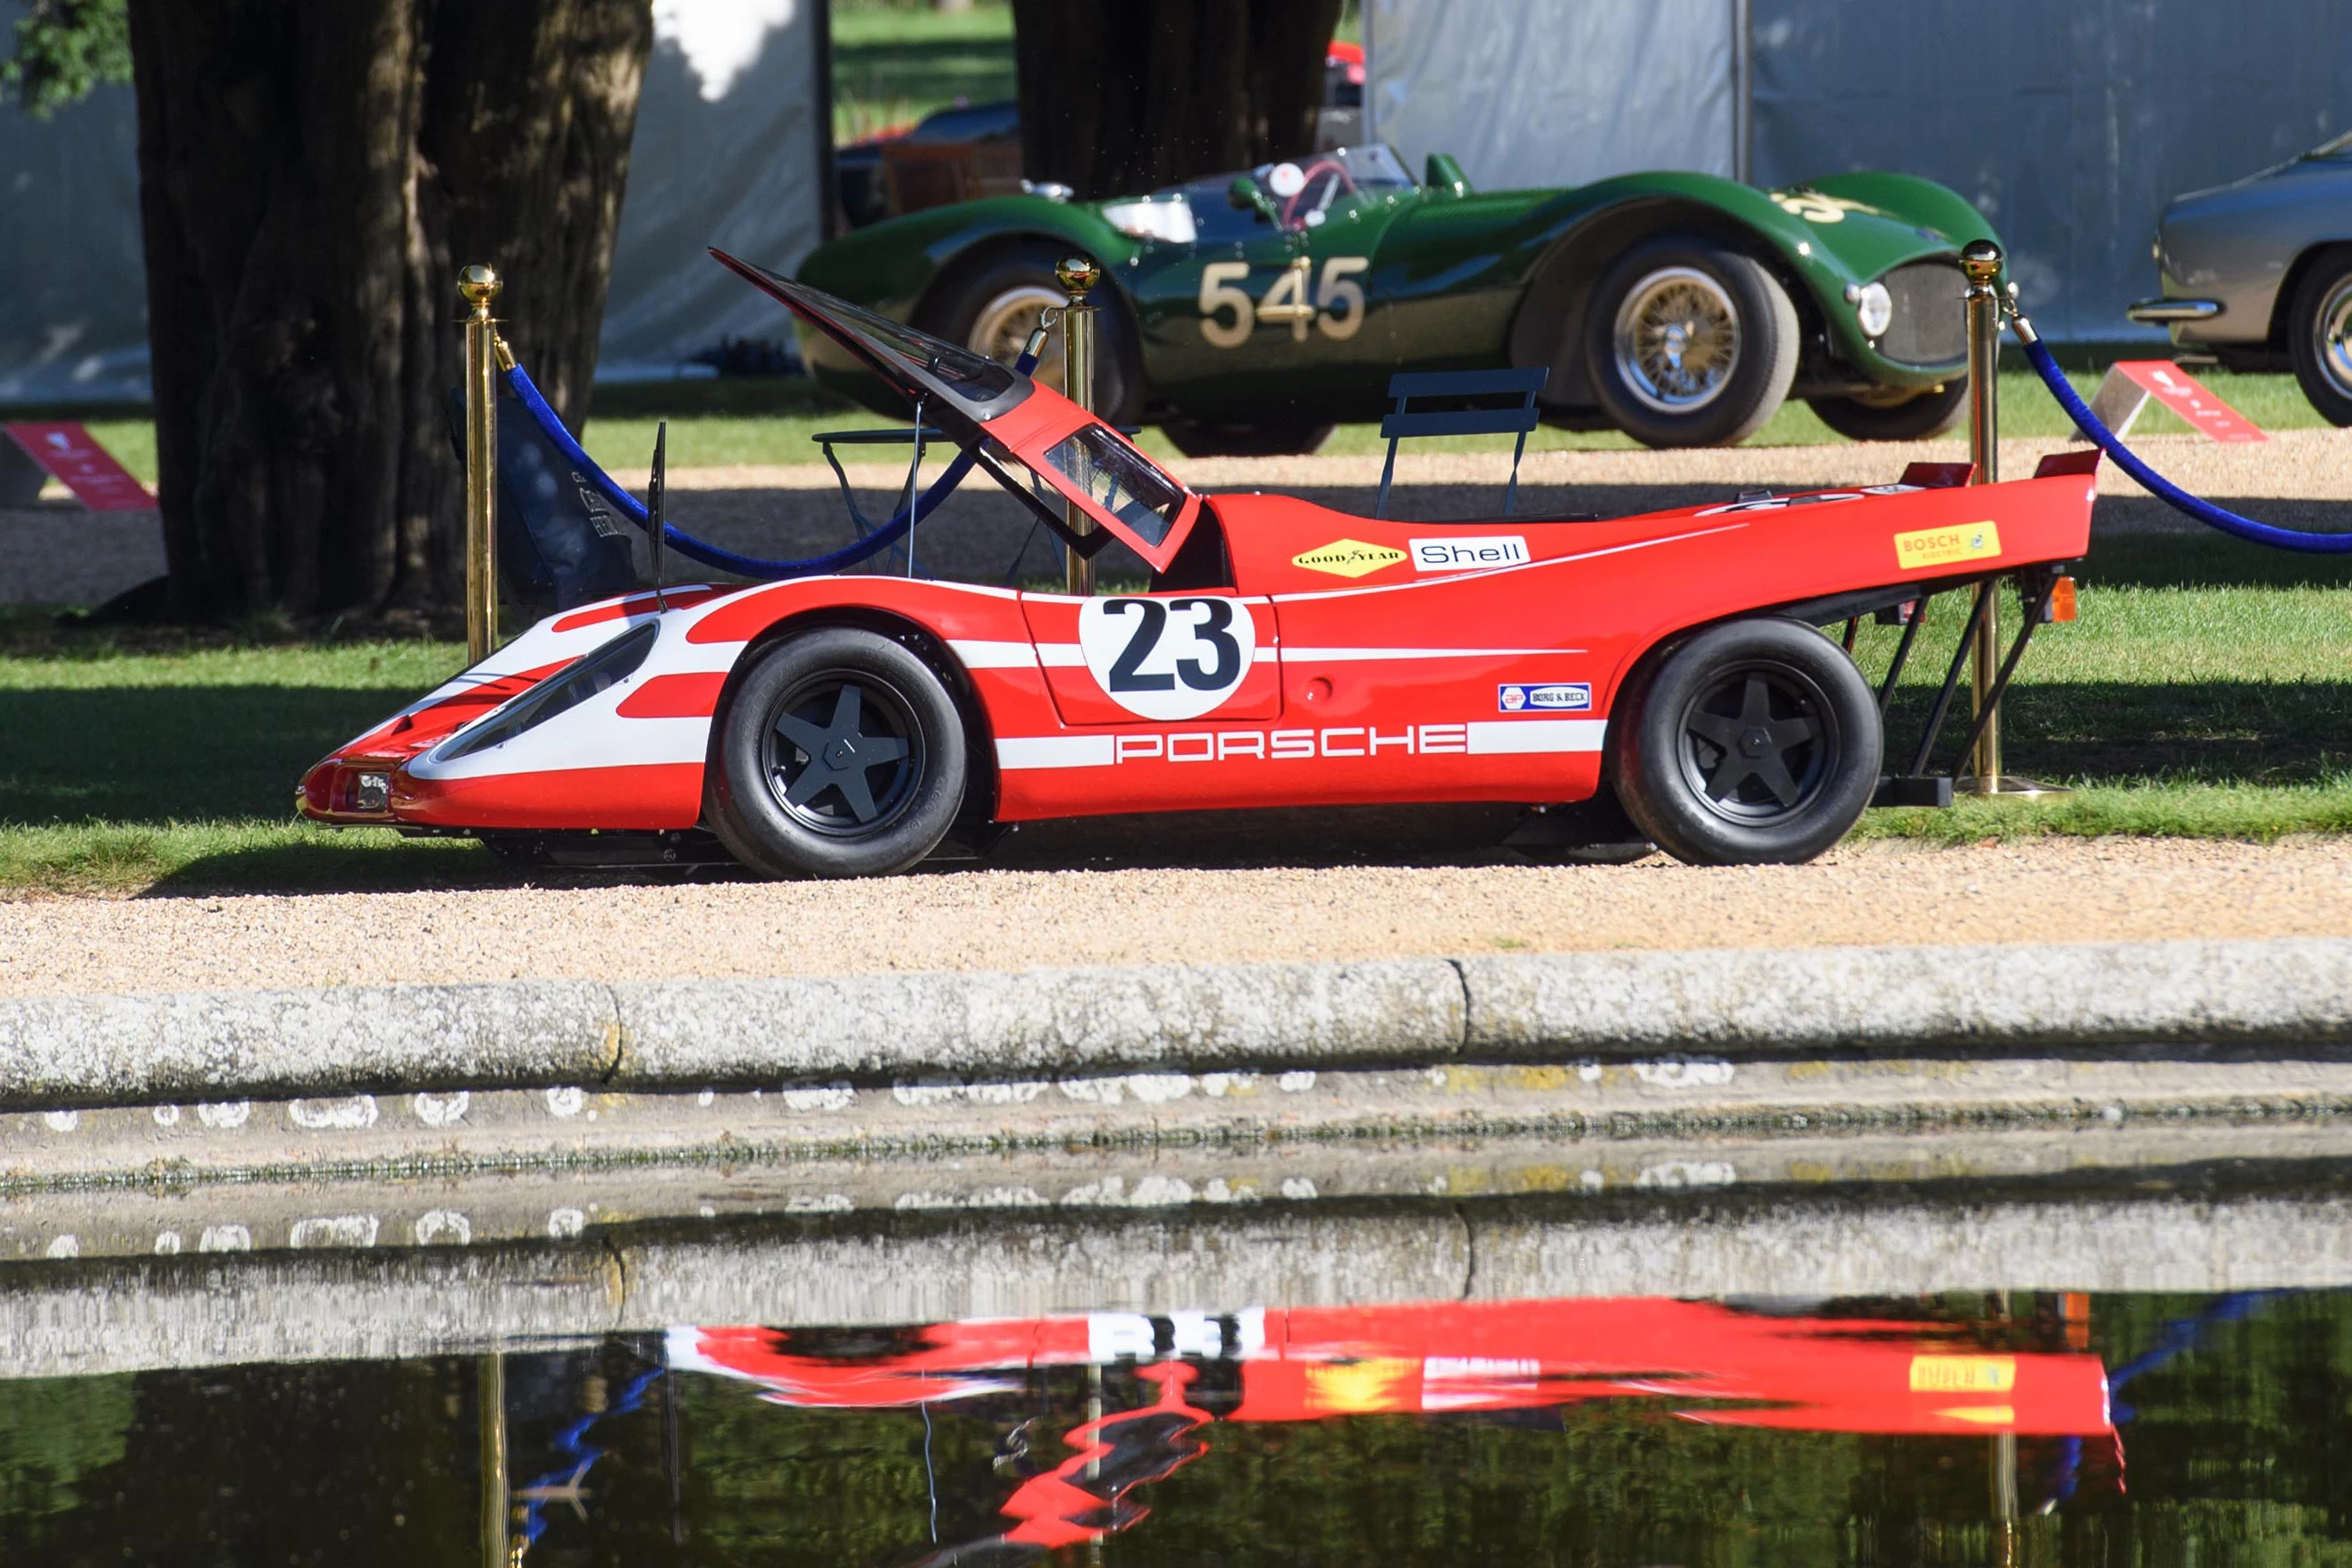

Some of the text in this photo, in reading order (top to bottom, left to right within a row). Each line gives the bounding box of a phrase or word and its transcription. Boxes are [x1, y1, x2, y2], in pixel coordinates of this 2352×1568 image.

[1199, 256, 1369, 349] 545
[1421, 543, 1521, 564] Shell
[1903, 533, 1960, 552] BOSCH
[1103, 598, 1240, 692] 23
[1533, 692, 1585, 702] BORG & BECK
[1115, 724, 1466, 764] PORSCHE
